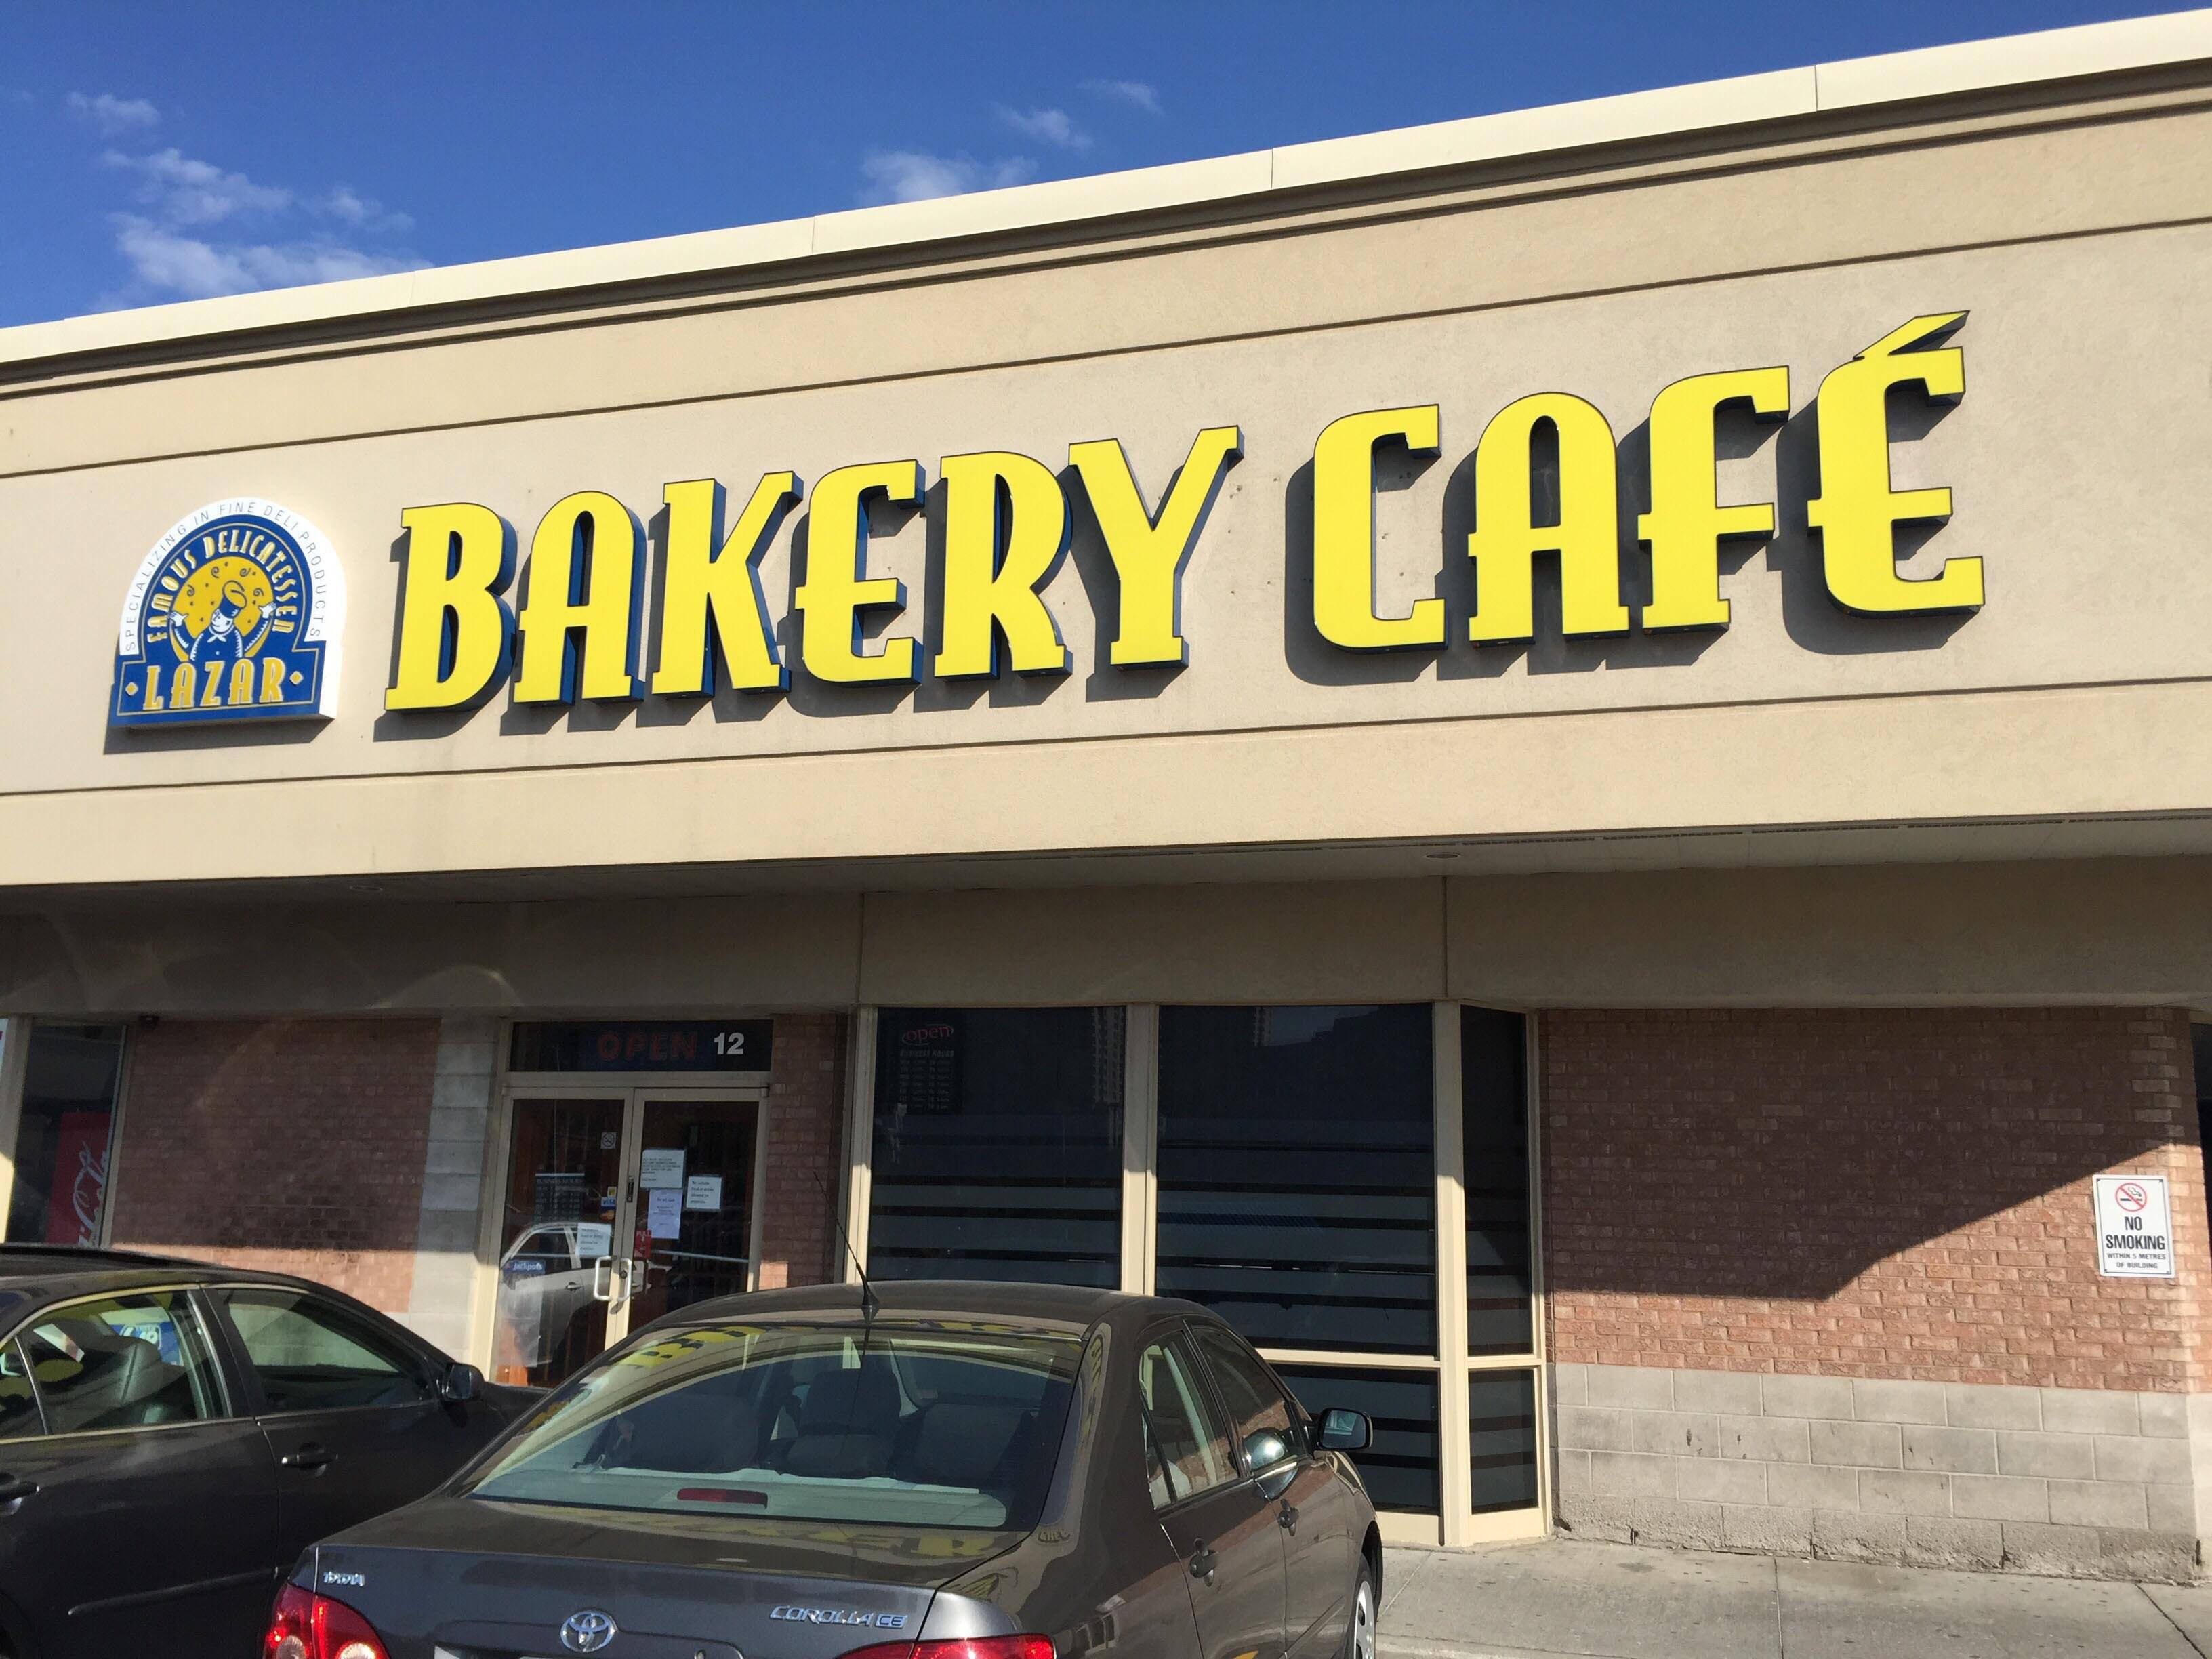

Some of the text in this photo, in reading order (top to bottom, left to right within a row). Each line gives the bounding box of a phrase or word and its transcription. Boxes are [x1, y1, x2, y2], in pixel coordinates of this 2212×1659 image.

[384, 310, 1986, 712] BAKERY CAFÉ
[125, 501, 327, 652] SPECIALIZING IN FINE DELI PRODUCTS
[146, 529, 298, 643] FAMOUS DELICATESSEN
[143, 657, 286, 711] LAZAR
[597, 1031, 697, 1061] OPEN
[714, 1032, 745, 1055] 12
[2124, 1216, 2143, 1231] NO
[2106, 1234, 2166, 1250] SMOKING
[769, 1605, 904, 1627] COROLLA CE
